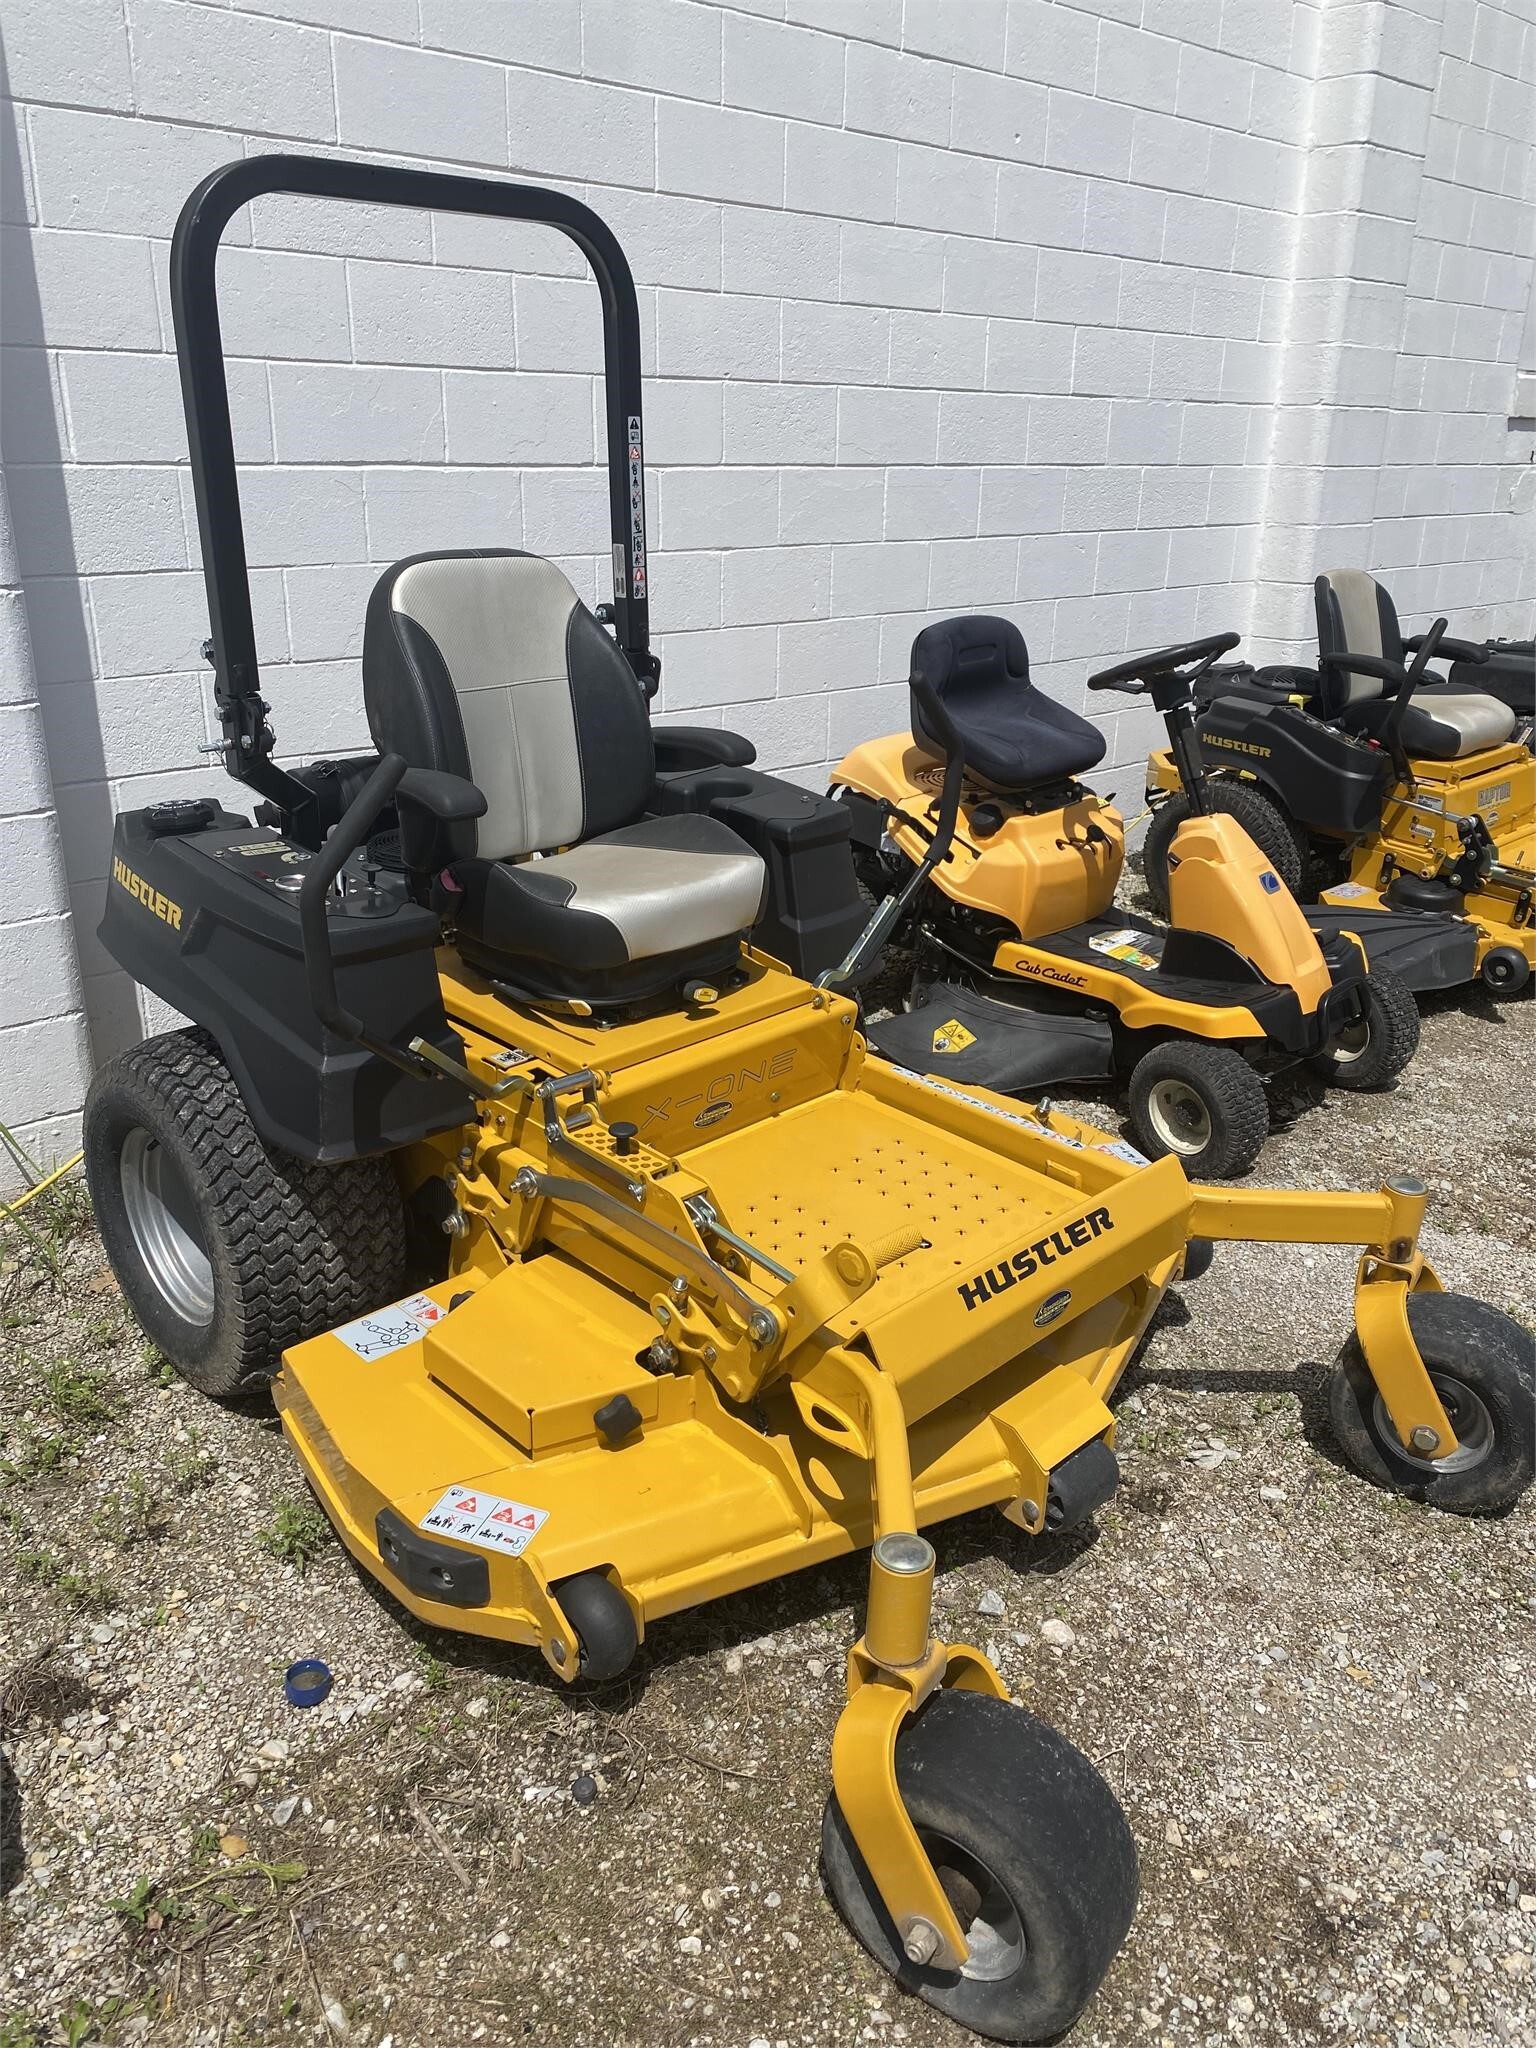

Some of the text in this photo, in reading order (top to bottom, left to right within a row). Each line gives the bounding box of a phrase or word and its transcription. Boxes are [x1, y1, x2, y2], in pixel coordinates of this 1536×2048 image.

[1202, 733, 1272, 758] HUSTLER
[113, 855, 182, 931] HUSTLER
[1015, 960, 1089, 988] Cub Cadet
[641, 1048, 798, 1129] X-ONE
[957, 1206, 1115, 1312] HUSTLER
